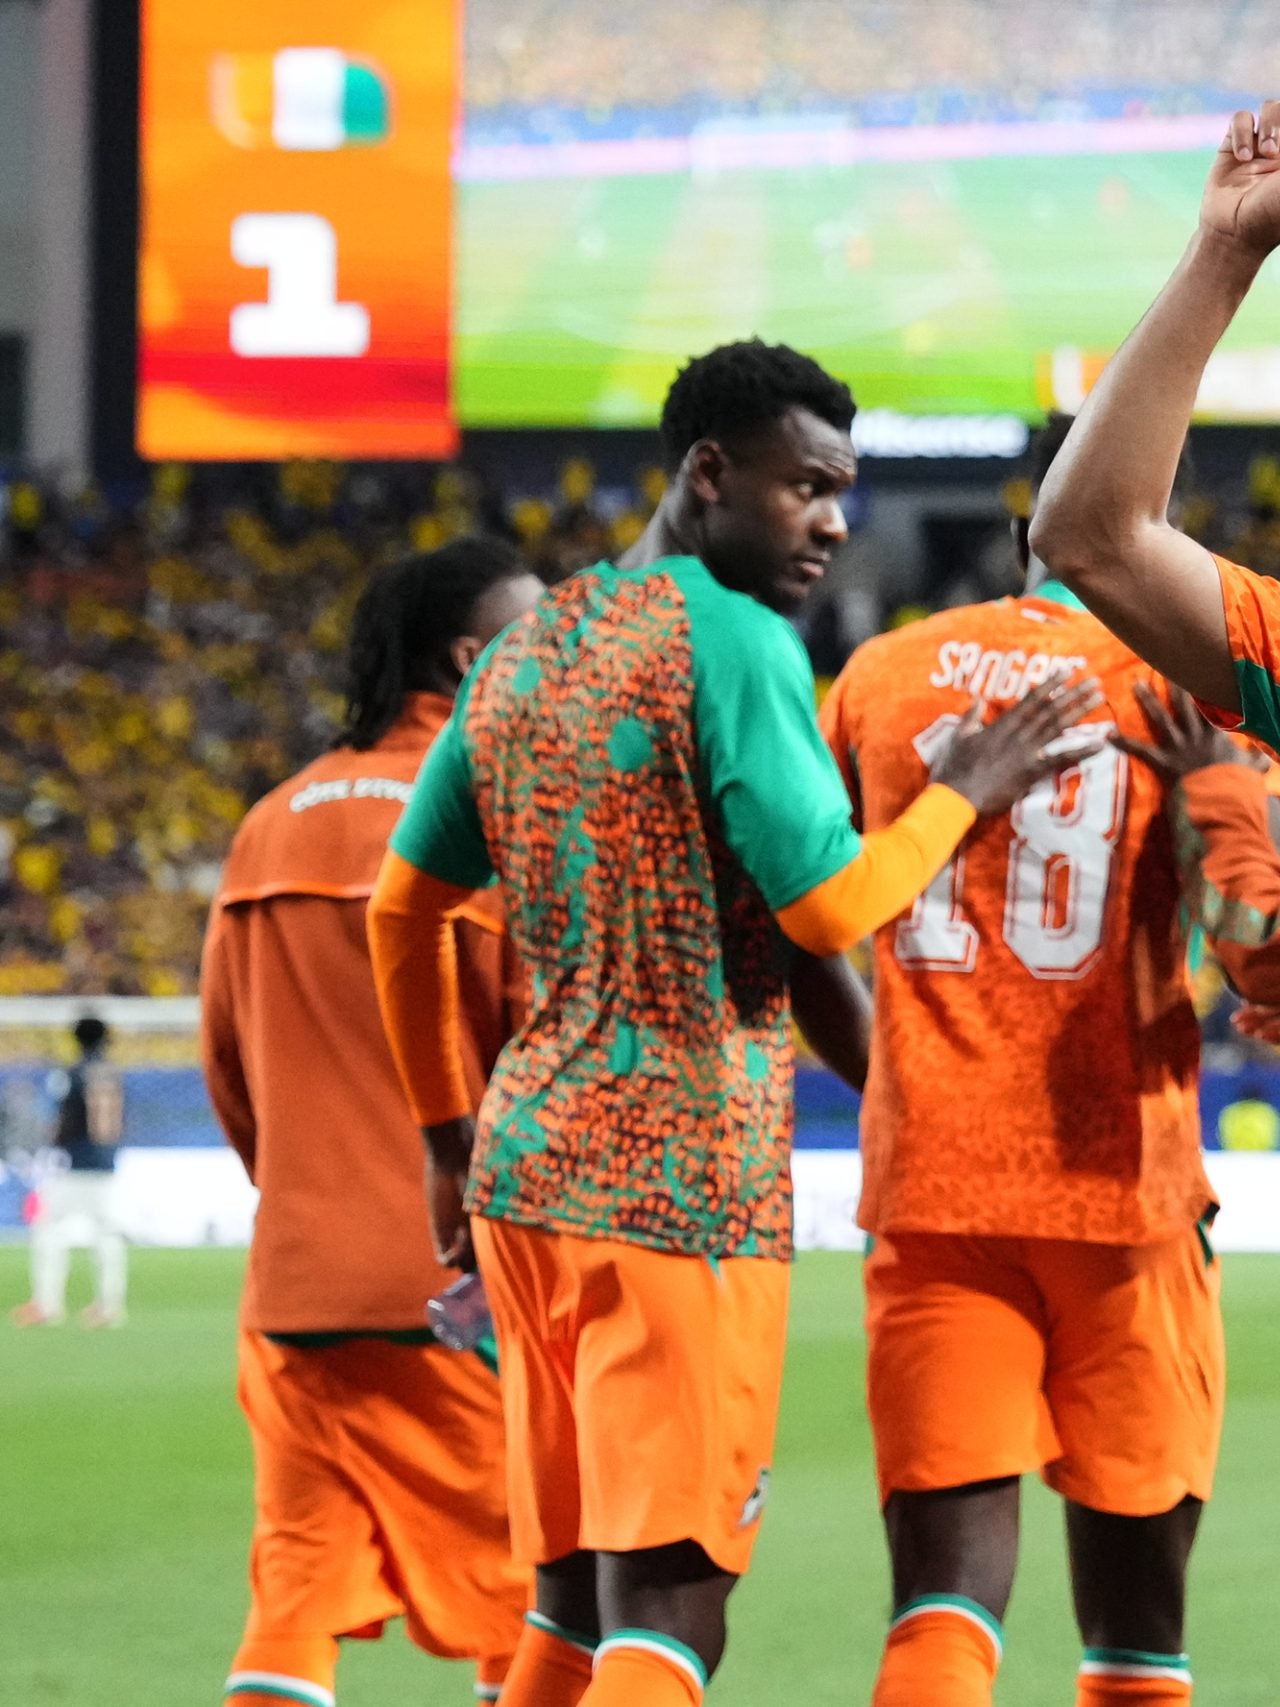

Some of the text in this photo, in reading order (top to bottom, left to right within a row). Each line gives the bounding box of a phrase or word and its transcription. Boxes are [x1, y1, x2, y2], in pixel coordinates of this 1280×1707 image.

[229, 212, 371, 358] 1
[929, 640, 1087, 700] SANGA
[895, 711, 1128, 980] 18
